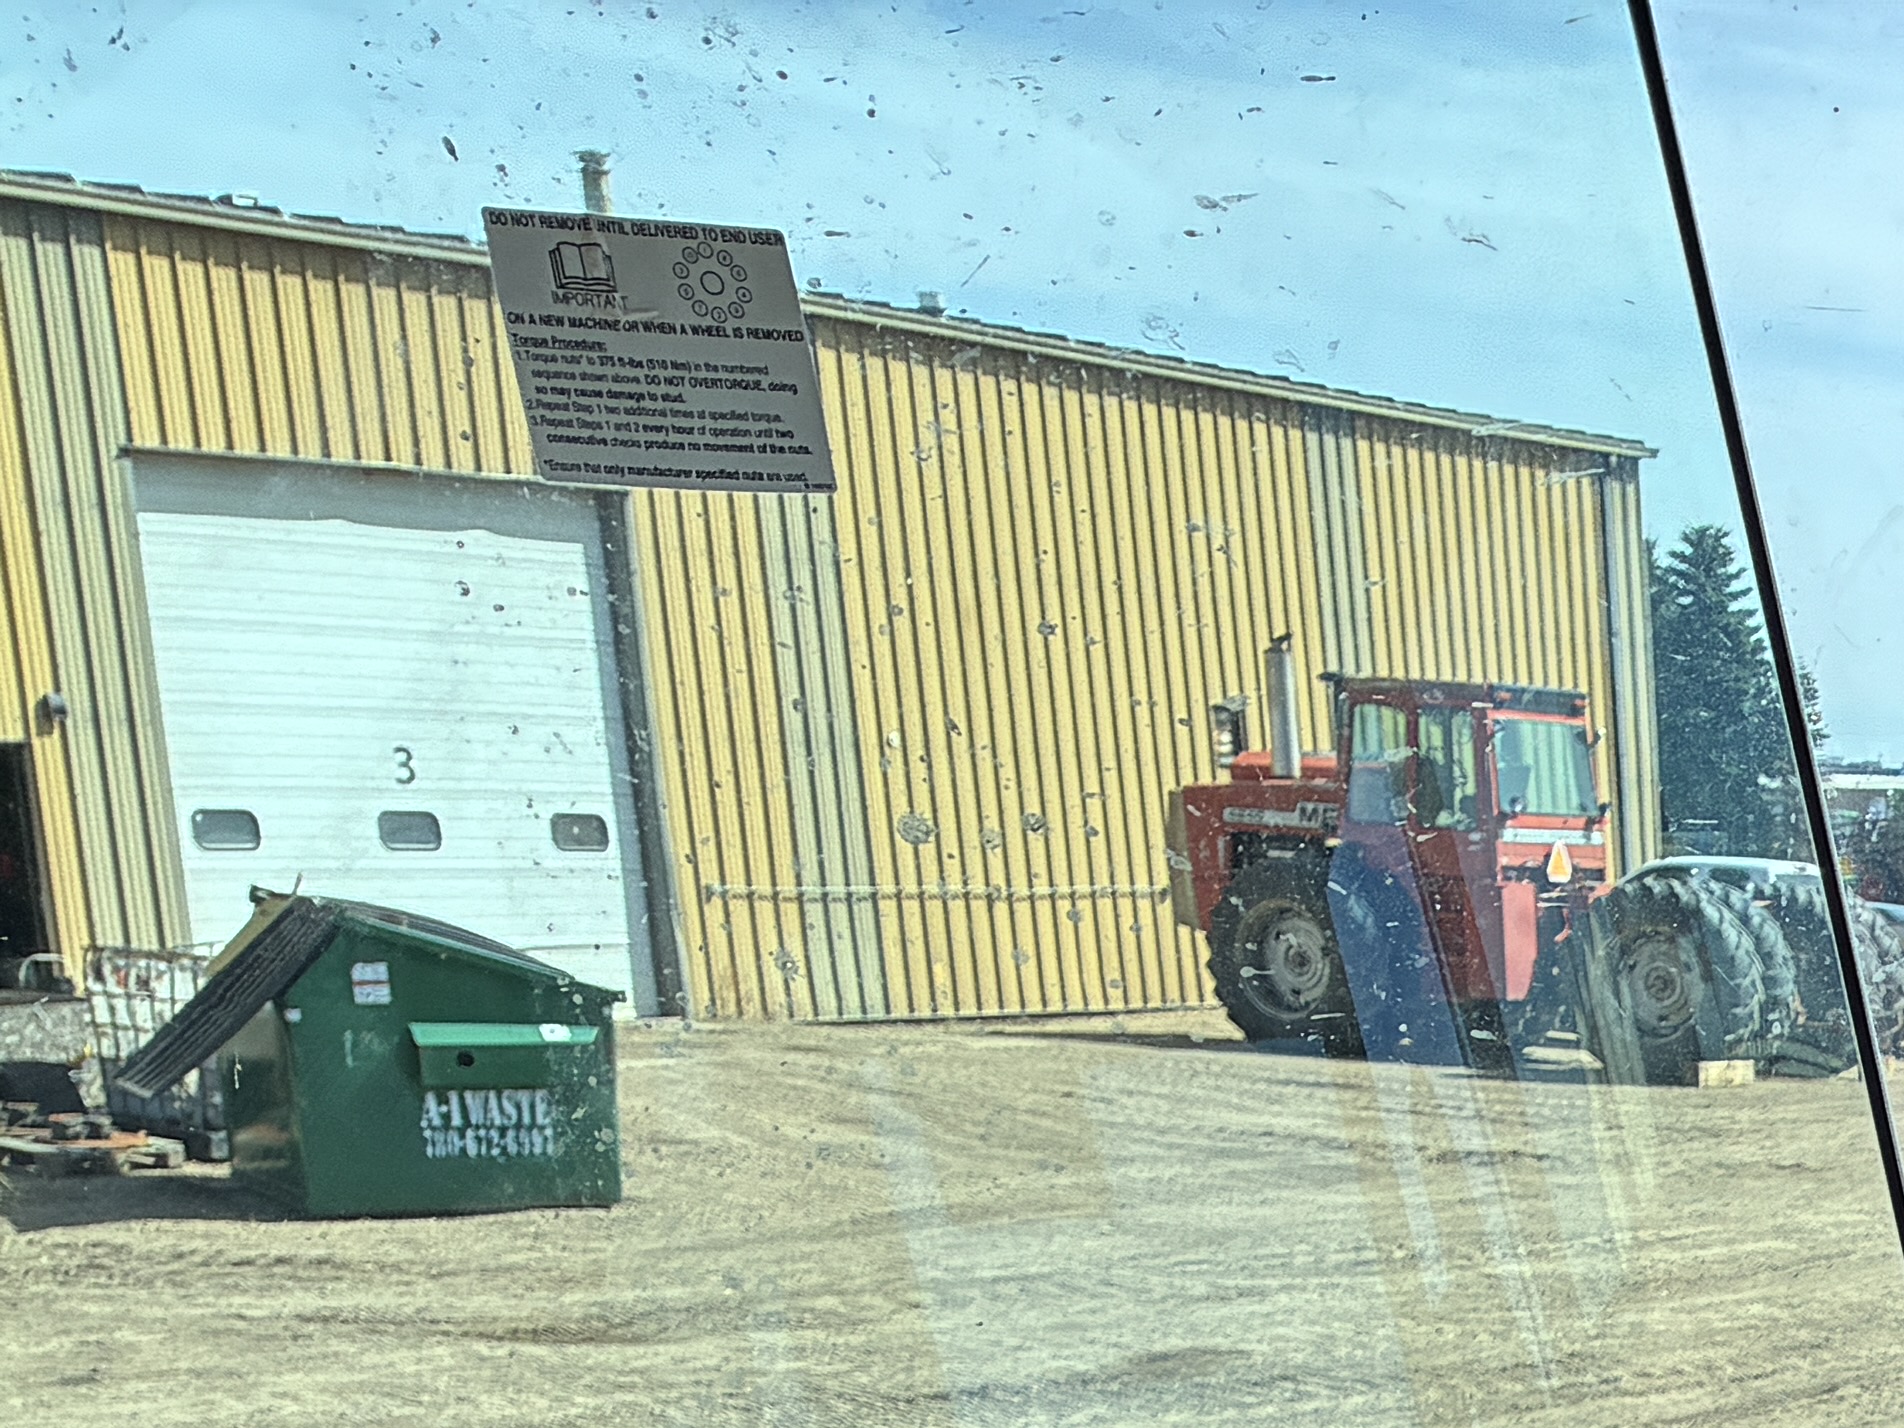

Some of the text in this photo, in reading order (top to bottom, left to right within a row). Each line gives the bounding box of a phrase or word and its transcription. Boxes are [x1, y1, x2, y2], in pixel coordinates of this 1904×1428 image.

[489, 211, 783, 246] DO NOT REMOVE UNTIL DELIVERED TO END USER
[507, 312, 804, 342] ON A NEW MACHINE OR WHEN A WHEEL IS REMOVED
[511, 333, 549, 348] Torque
[586, 355, 596, 365] to
[704, 361, 719, 373] the
[721, 363, 769, 376] numbered
[531, 369, 576, 382] sequence
[645, 374, 661, 385] DO
[663, 375, 685, 387] NOT
[688, 376, 766, 392] OVERTORQUE,
[768, 381, 798, 395] doing
[550, 386, 571, 400] may
[574, 387, 604, 399] cause
[606, 388, 645, 402] damage
[647, 390, 658, 401] to
[572, 401, 594, 415] Step
[623, 405, 668, 418] additional
[669, 408, 695, 420] times
[708, 410, 750, 423] specified
[576, 417, 604, 431] Steps
[614, 422, 632, 433] and
[642, 423, 669, 437] every
[671, 424, 695, 436] hour
[709, 426, 752, 438] operation
[547, 433, 608, 447] consecutive
[644, 440, 686, 452] produce
[702, 441, 754, 454] movement
[603, 464, 625, 477] only
[695, 468, 740, 482] specified
[393, 746, 417, 785] 3
[463, 1088, 554, 1128] WASTE
